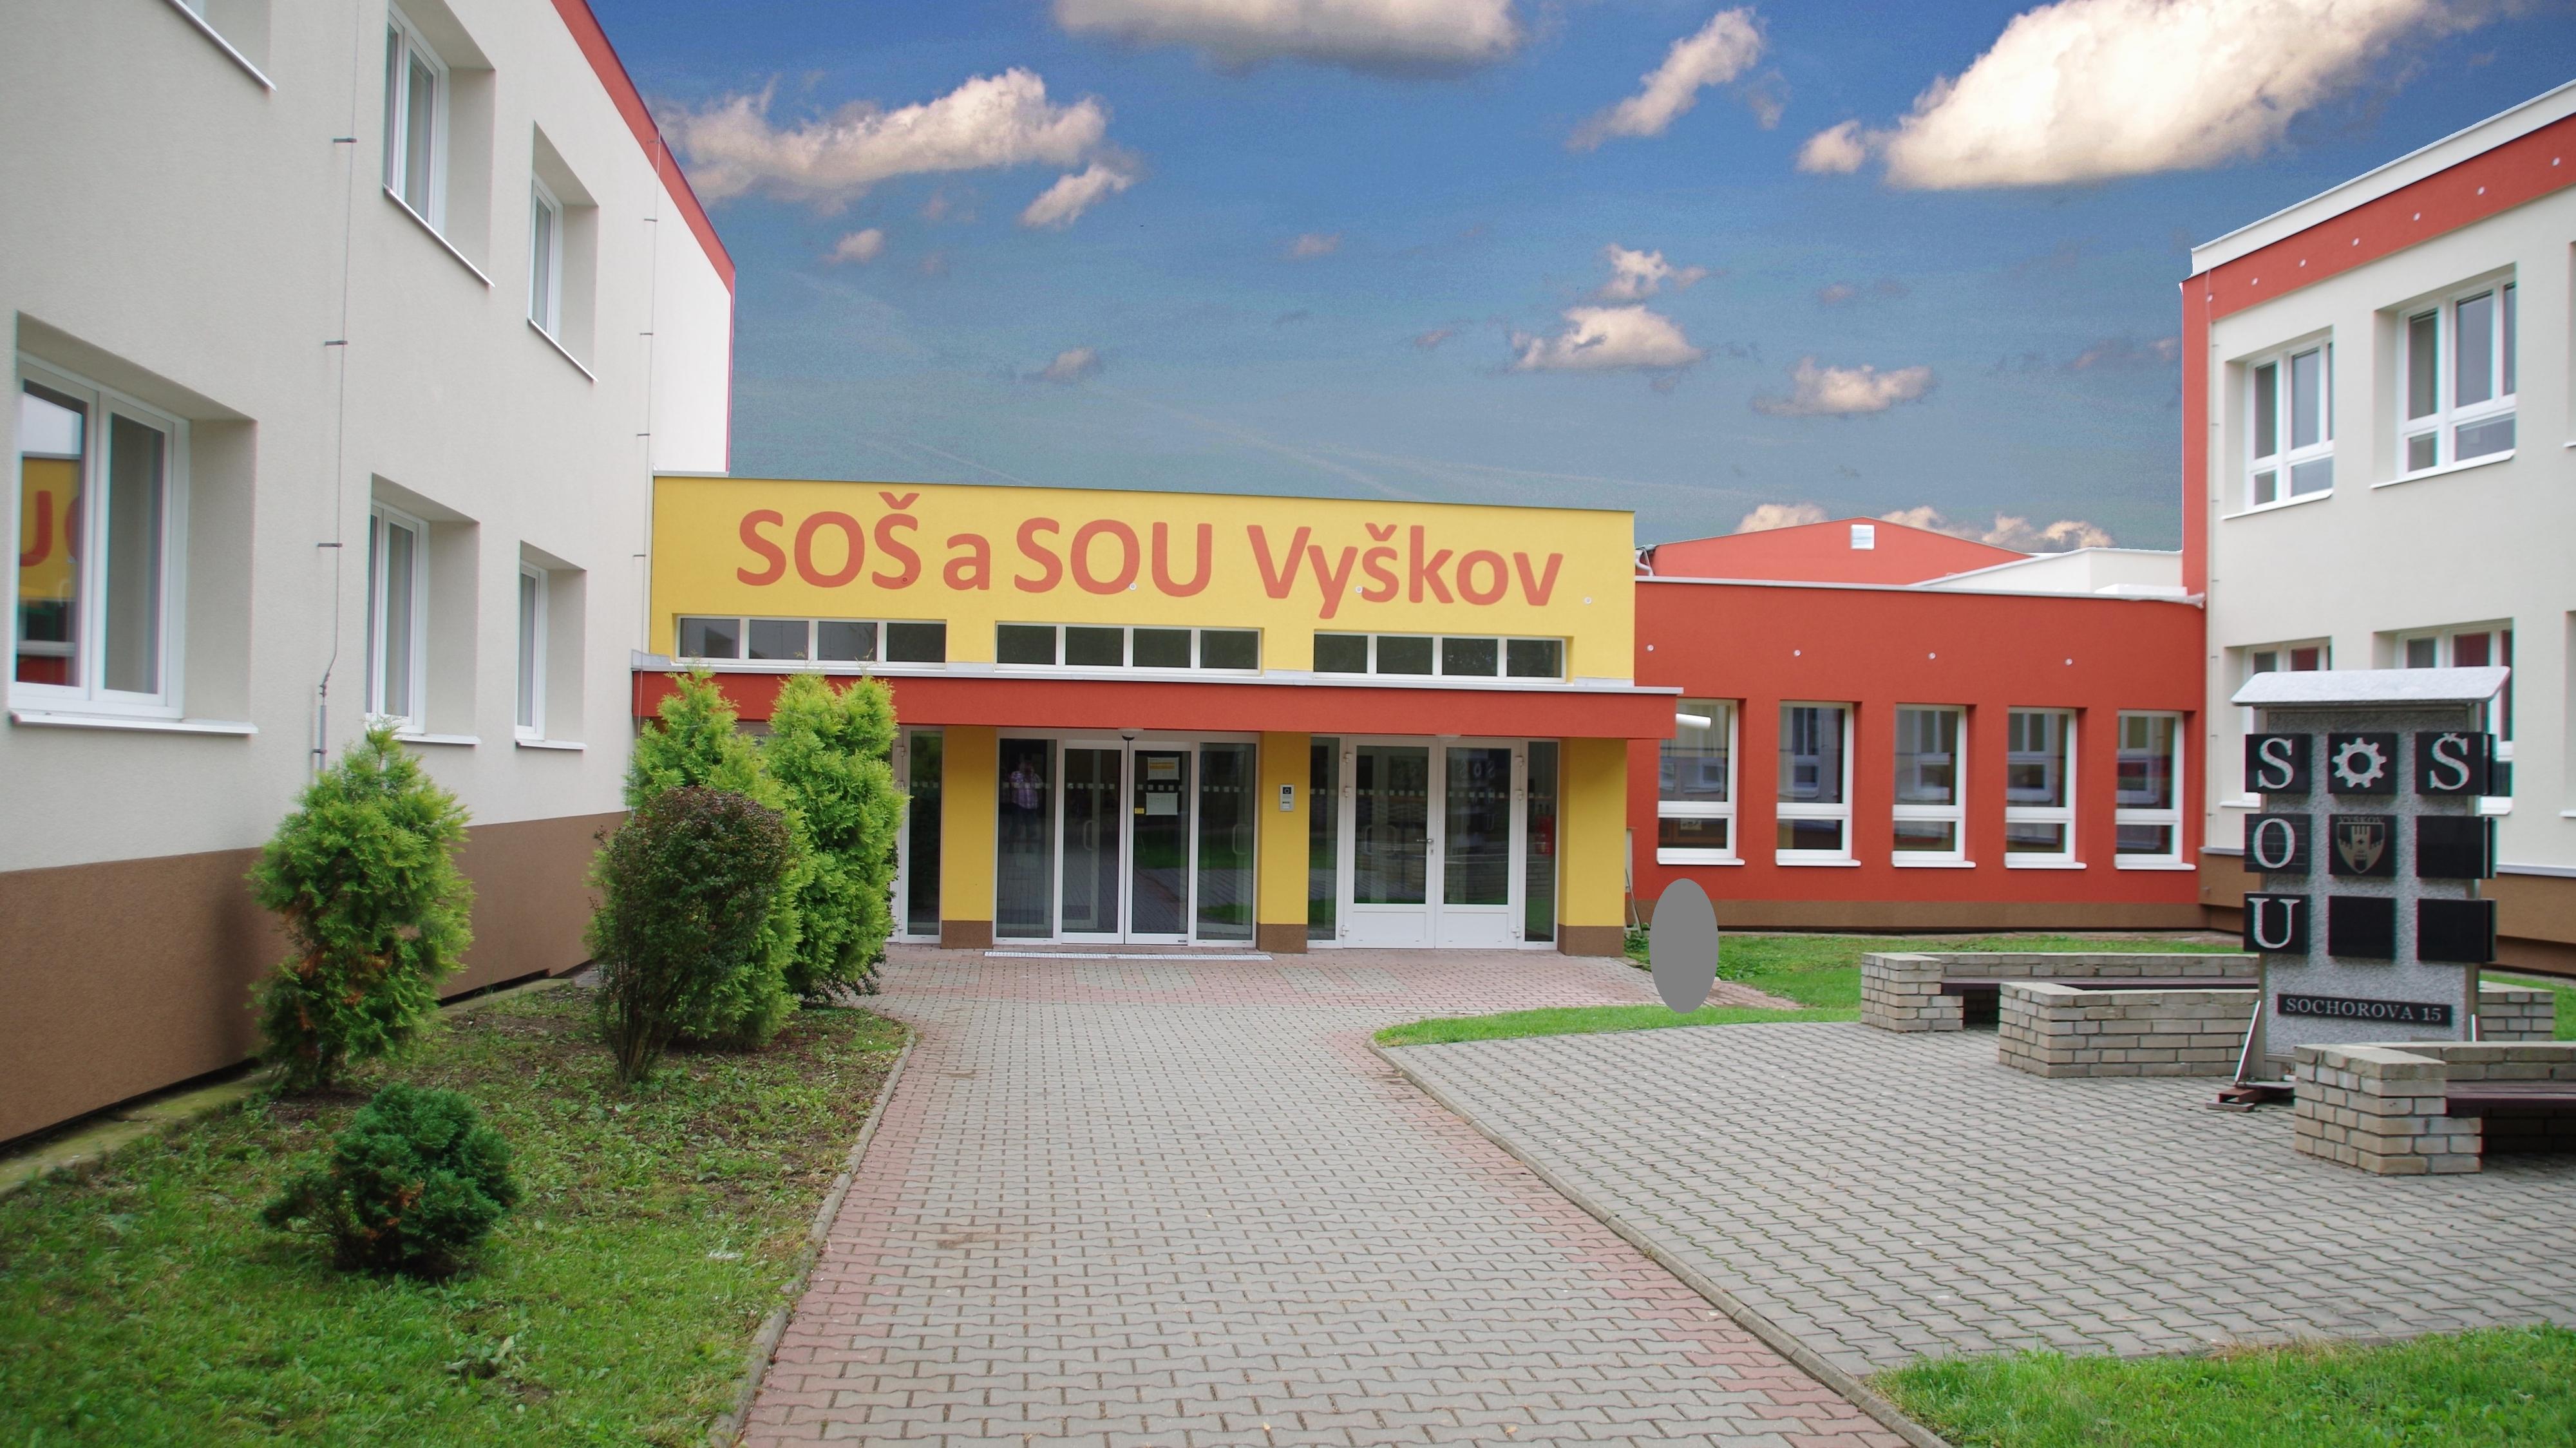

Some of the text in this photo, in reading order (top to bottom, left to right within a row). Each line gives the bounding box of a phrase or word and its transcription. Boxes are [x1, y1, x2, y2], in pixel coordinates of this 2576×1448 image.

[737, 491, 1563, 619] SOŠ a SOU Vyškov
[2286, 998, 2442, 1021] SOCHOROVA 15
